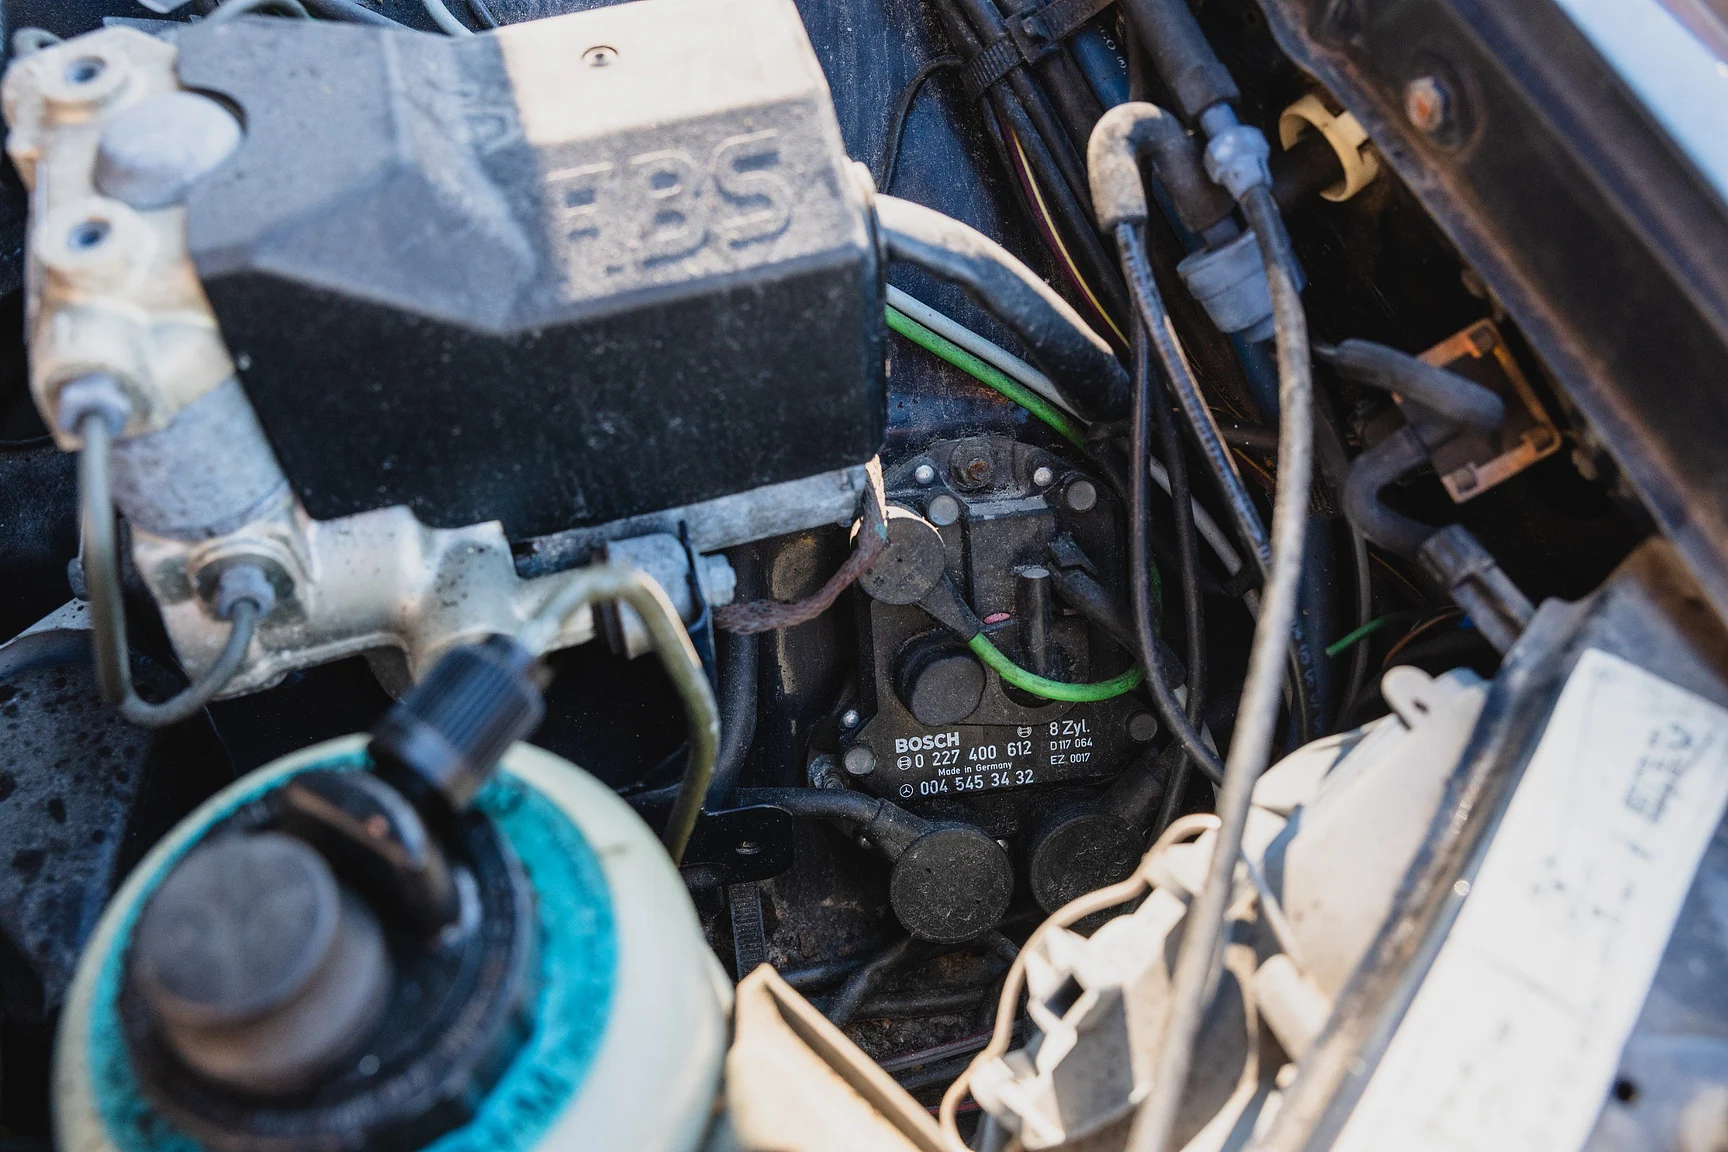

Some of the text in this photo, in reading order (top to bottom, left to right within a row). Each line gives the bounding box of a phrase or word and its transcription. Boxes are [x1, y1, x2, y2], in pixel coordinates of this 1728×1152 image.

[1049, 719, 1091, 738] 8 Zyl.
[895, 731, 960, 754] BOSCH
[1074, 738, 1093, 749] 064
[914, 740, 1033, 769] 0 227 400 612
[1050, 752, 1091, 765] EZ 0017
[938, 760, 1013, 777] Made in Germany
[920, 769, 1034, 796] 004 545 34 32
